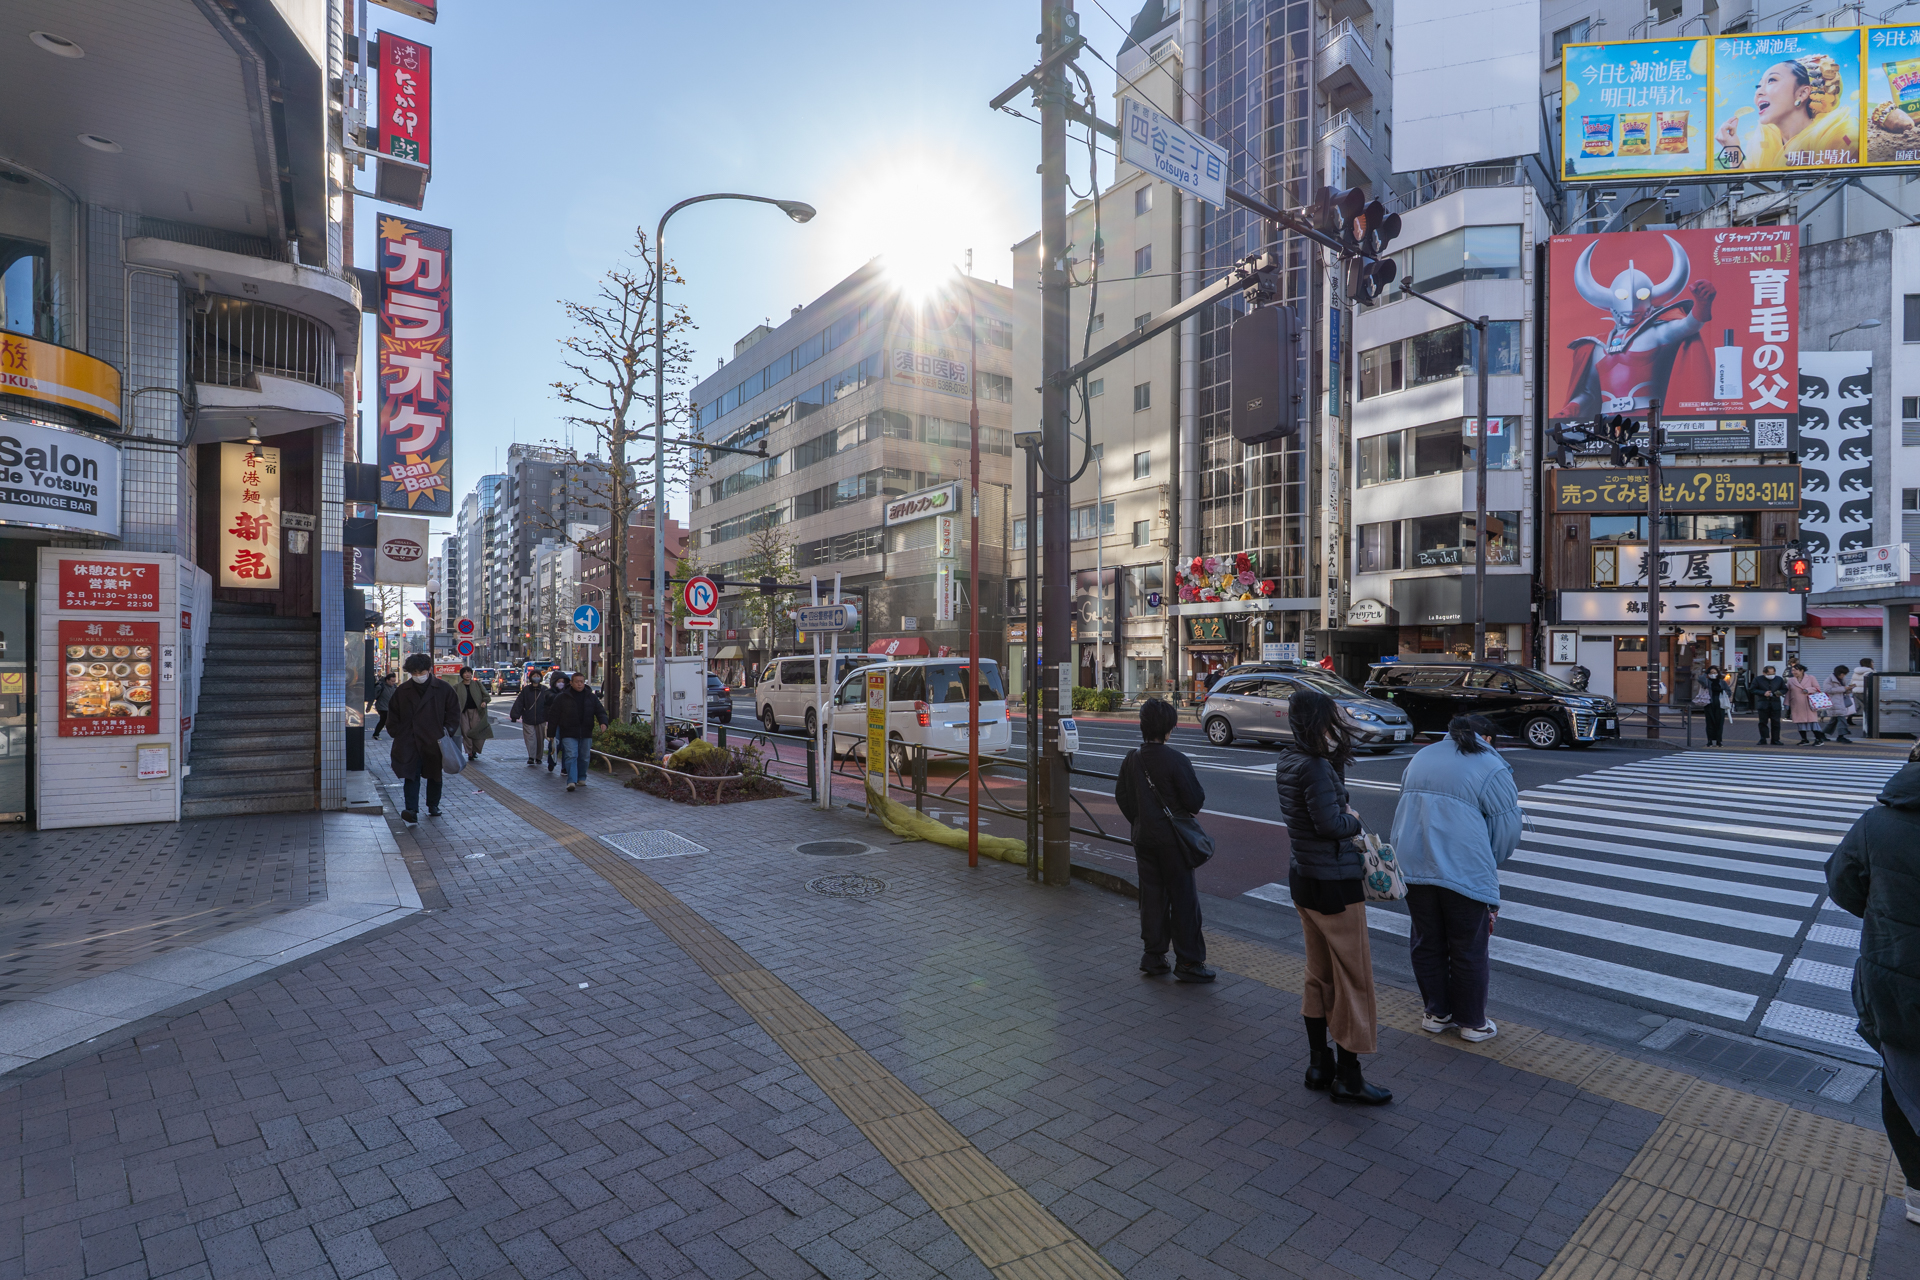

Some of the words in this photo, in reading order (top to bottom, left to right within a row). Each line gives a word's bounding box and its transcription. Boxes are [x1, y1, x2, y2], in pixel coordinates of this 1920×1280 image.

[1719, 38, 1802, 56] 今日も湖池屋。
[1581, 60, 1692, 85] 今日も湖池屋。
[1600, 85, 1692, 108] 明日は晴れ。
[1132, 101, 1159, 124] 新宿区
[1131, 114, 1220, 181] 四谷三丁目
[1787, 149, 1857, 166] 明日は晴れ。
[1723, 151, 1739, 165] 湖
[1154, 153, 1190, 183] Yotsuya
[1192, 173, 1199, 187] 3
[389, 237, 443, 453] カラオケ
[1748, 268, 1790, 410] 育毛の父
[896, 350, 965, 383] 須田医院
[937, 379, 969, 395] 5366-0760
[0, 436, 98, 481] Salon
[264, 453, 278, 475] 三宿
[391, 460, 431, 480] Ban
[1715, 473, 1731, 483] 03
[29, 470, 98, 498] Yotsuya
[404, 474, 443, 494] Ban
[1715, 482, 1795, 502] 5793-3141
[11, 492, 67, 508] LOUNGE
[70, 500, 92, 512] BAR
[284, 517, 312, 528] 営業中
[228, 511, 272, 579] 新記
[943, 519, 951, 555] カラオケ
[385, 545, 421, 556] ウマウマ
[1417, 552, 1437, 565] Bar
[1440, 550, 1458, 564] Jail
[73, 564, 146, 577] 休憩なしで
[1845, 563, 1892, 577] 四谷三丁目駅
[88, 578, 131, 590] 営業中
[66, 599, 120, 607] ラストオーダー
[1350, 611, 1383, 619] アゼリアビル
[1435, 613, 1461, 622] Baguette
[85, 623, 134, 636] 新記
